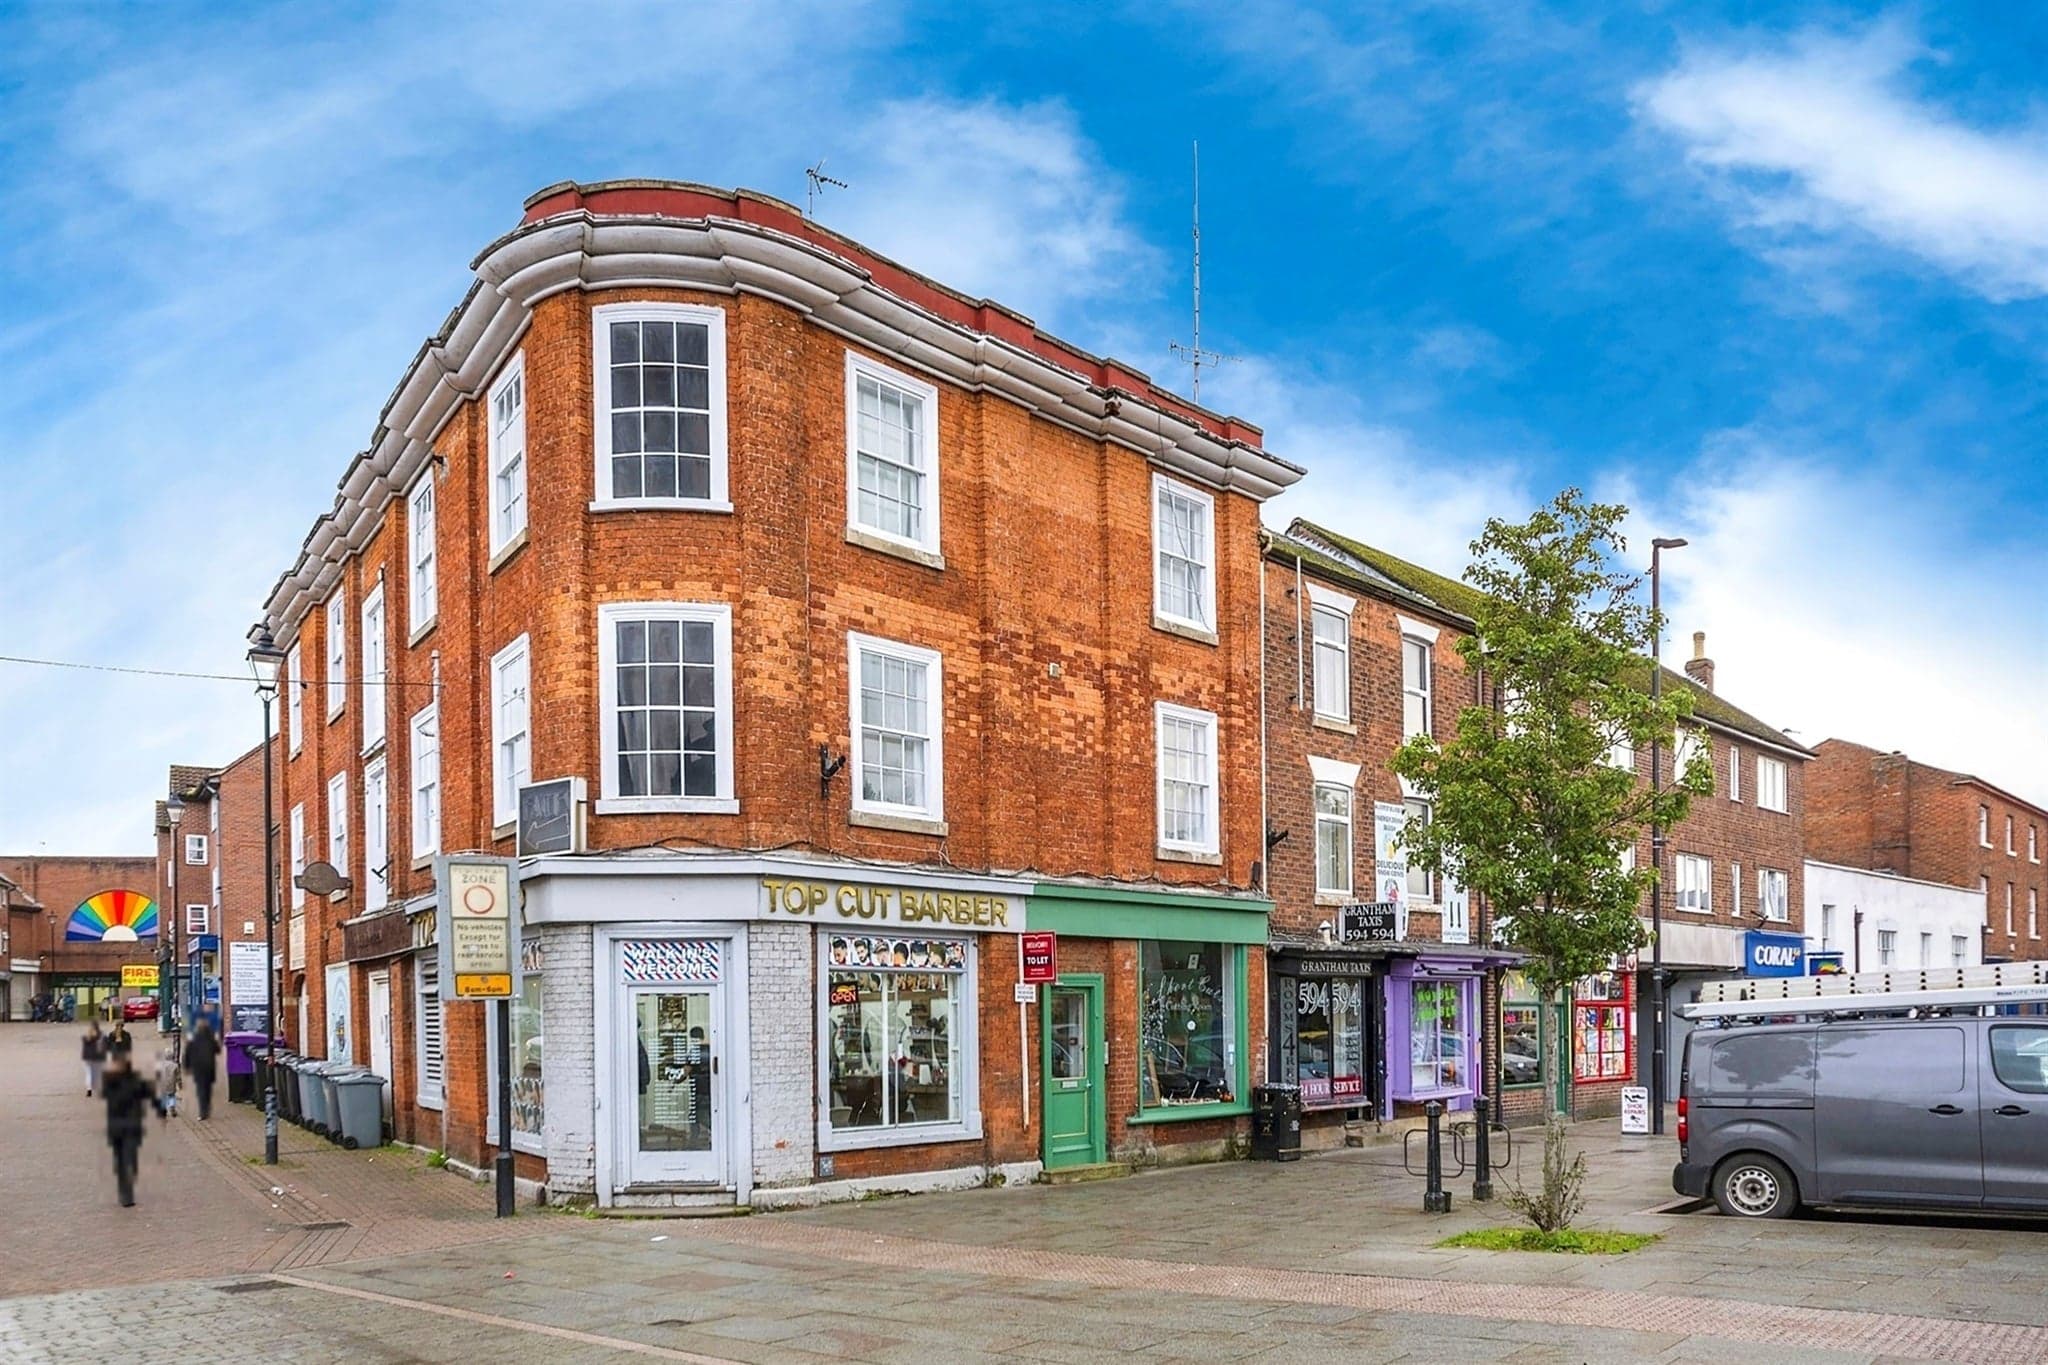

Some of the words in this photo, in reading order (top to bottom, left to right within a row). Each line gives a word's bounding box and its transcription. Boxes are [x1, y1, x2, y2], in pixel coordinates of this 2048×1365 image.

[462, 874, 497, 885] ZONE
[762, 880, 828, 916] TOP
[835, 885, 892, 920] CUT
[900, 890, 1009, 927] BARBER
[1344, 904, 1396, 917] GRANTHAM
[1358, 916, 1384, 927] TAXIS
[1346, 929, 1369, 941] 594
[1372, 927, 1395, 940] 594
[632, 947, 677, 960] WALK
[1754, 945, 1796, 966] CORAL
[1027, 956, 1037, 965] TO
[1037, 956, 1049, 965] LET
[1301, 960, 1348, 972] GRANTHAM
[632, 962, 712, 975] WELCOME
[831, 990, 857, 1003] OPEN
[1298, 981, 1330, 1016] 594
[1332, 982, 1361, 1016] 594
[1284, 979, 1294, 1034] ROOMS
[1282, 1032, 1296, 1057] 4
[1310, 1082, 1331, 1096] HOUR
[1333, 1080, 1361, 1093] SERVICE
